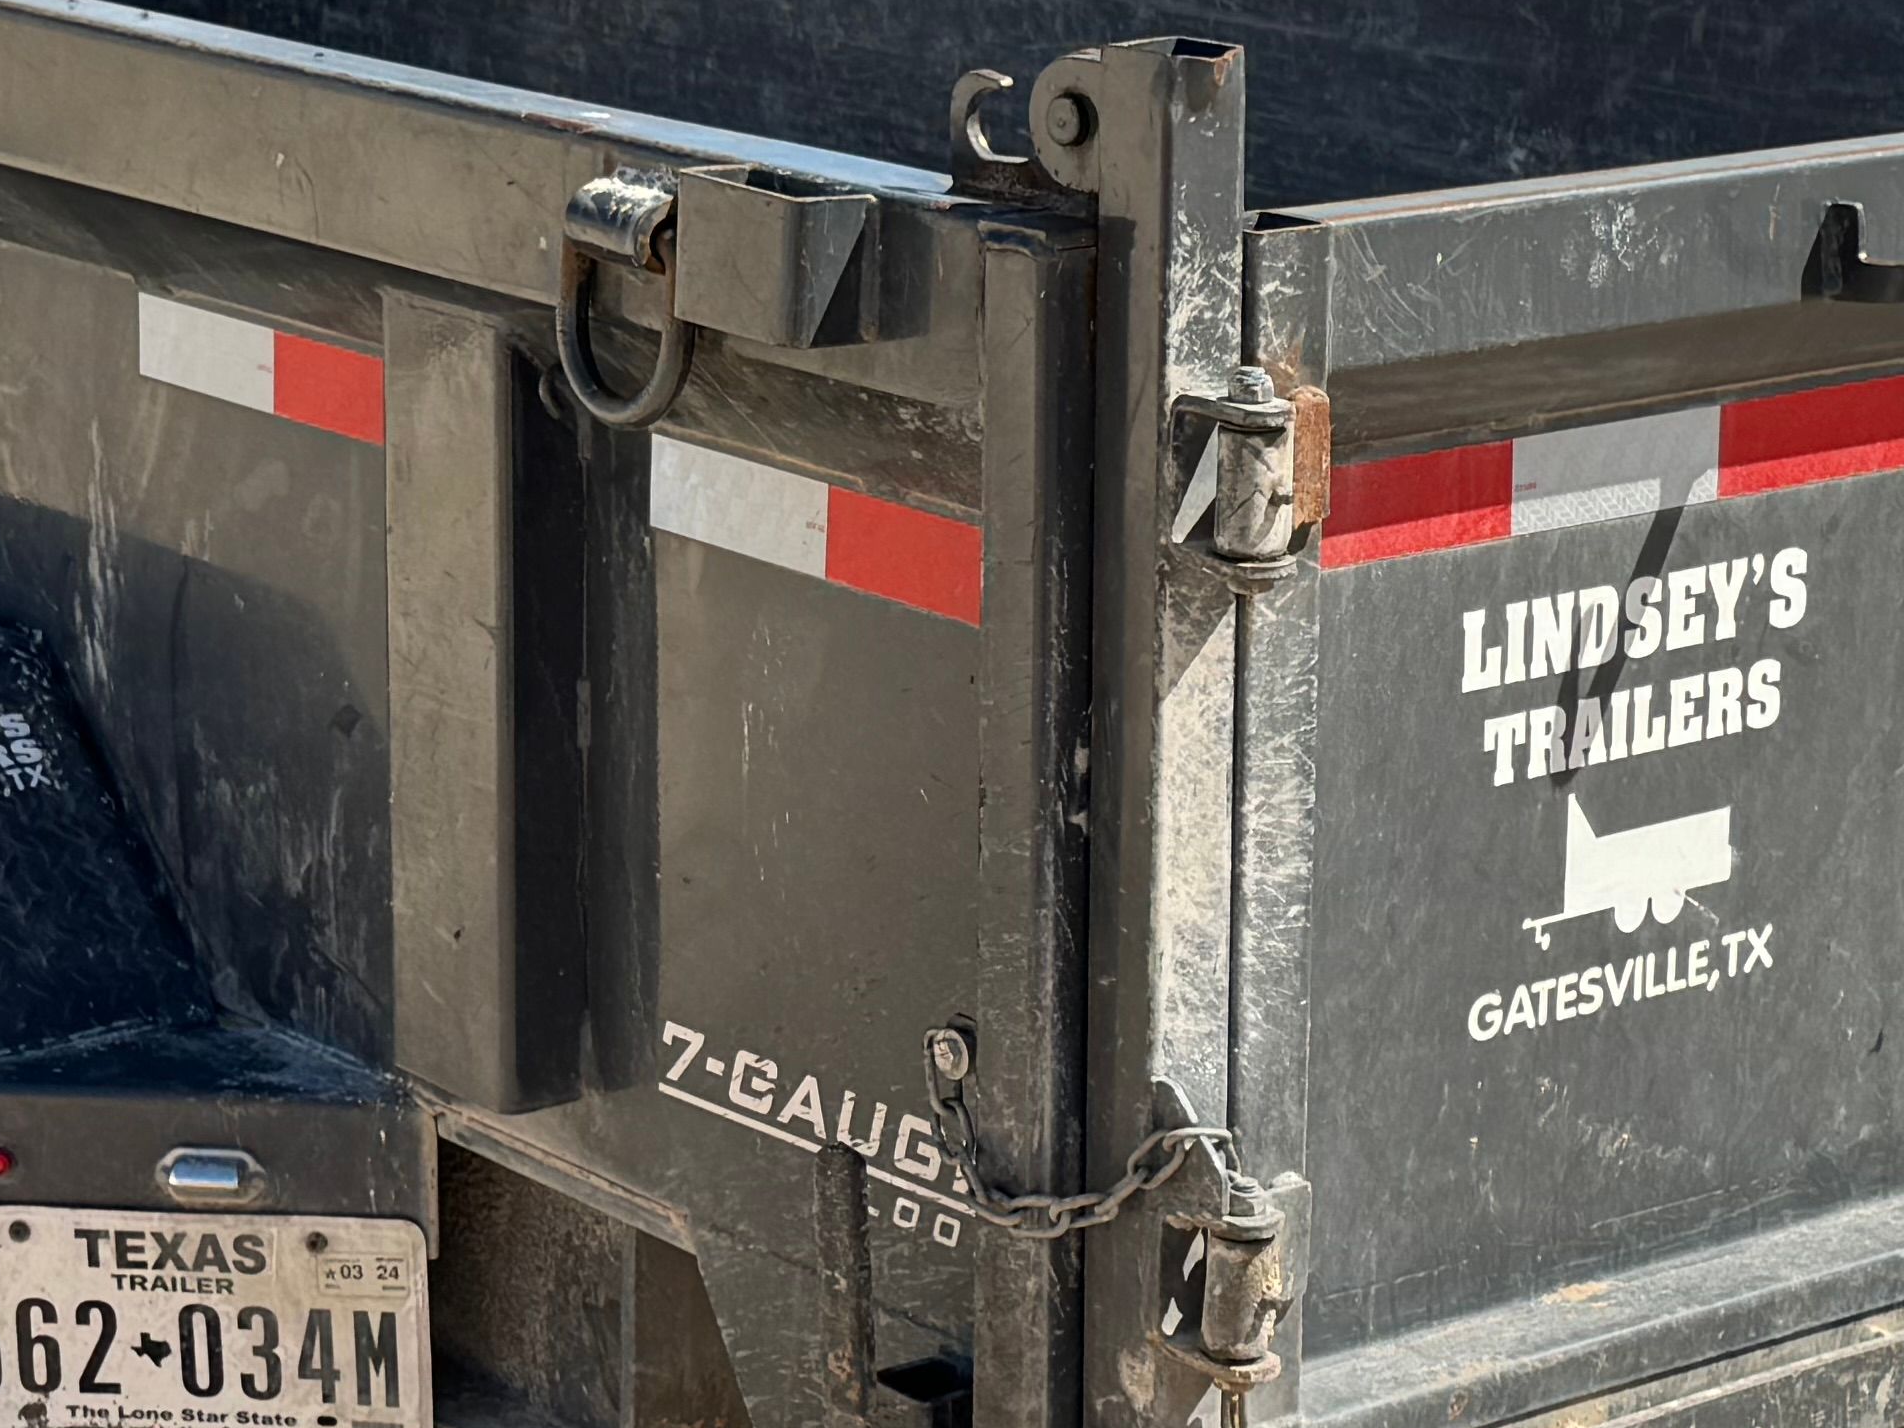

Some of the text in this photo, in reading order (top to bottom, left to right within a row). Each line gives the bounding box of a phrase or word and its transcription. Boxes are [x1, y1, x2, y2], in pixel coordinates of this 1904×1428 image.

[1460, 546, 1809, 694] LINDSEY'S
[1483, 658, 1782, 788] TRAILERS
[662, 1020, 969, 1194] 7-GAUG
[73, 1227, 268, 1275] TEXAS
[339, 1263, 400, 1281] 03 24
[110, 1273, 235, 1296] TRAILER
[66, 1404, 298, 1427] The Lone Star State
